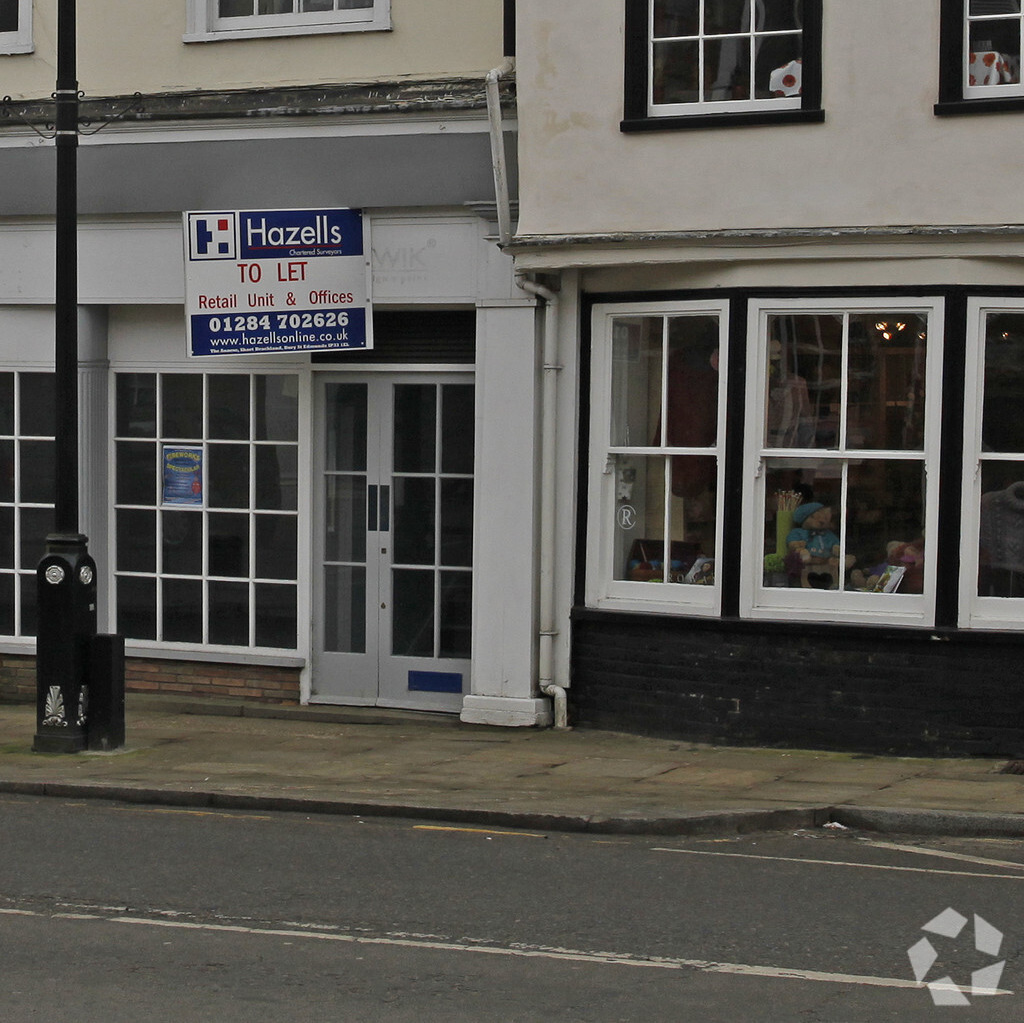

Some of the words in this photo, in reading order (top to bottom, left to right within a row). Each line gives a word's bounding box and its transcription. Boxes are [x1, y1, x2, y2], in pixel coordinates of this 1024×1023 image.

[246, 215, 342, 246] Hazells
[288, 248, 316, 256] Chartered
[317, 248, 342, 257] Surveyors
[237, 263, 262, 283] TO
[277, 261, 308, 282] LET
[198, 294, 237, 309] Retail
[248, 293, 275, 307] Unit
[286, 291, 297, 306] &
[309, 290, 354, 305] Offices
[209, 315, 271, 332] 01284
[277, 312, 349, 329] 702626
[210, 328, 348, 346] www.hazellsonline.co.uk
